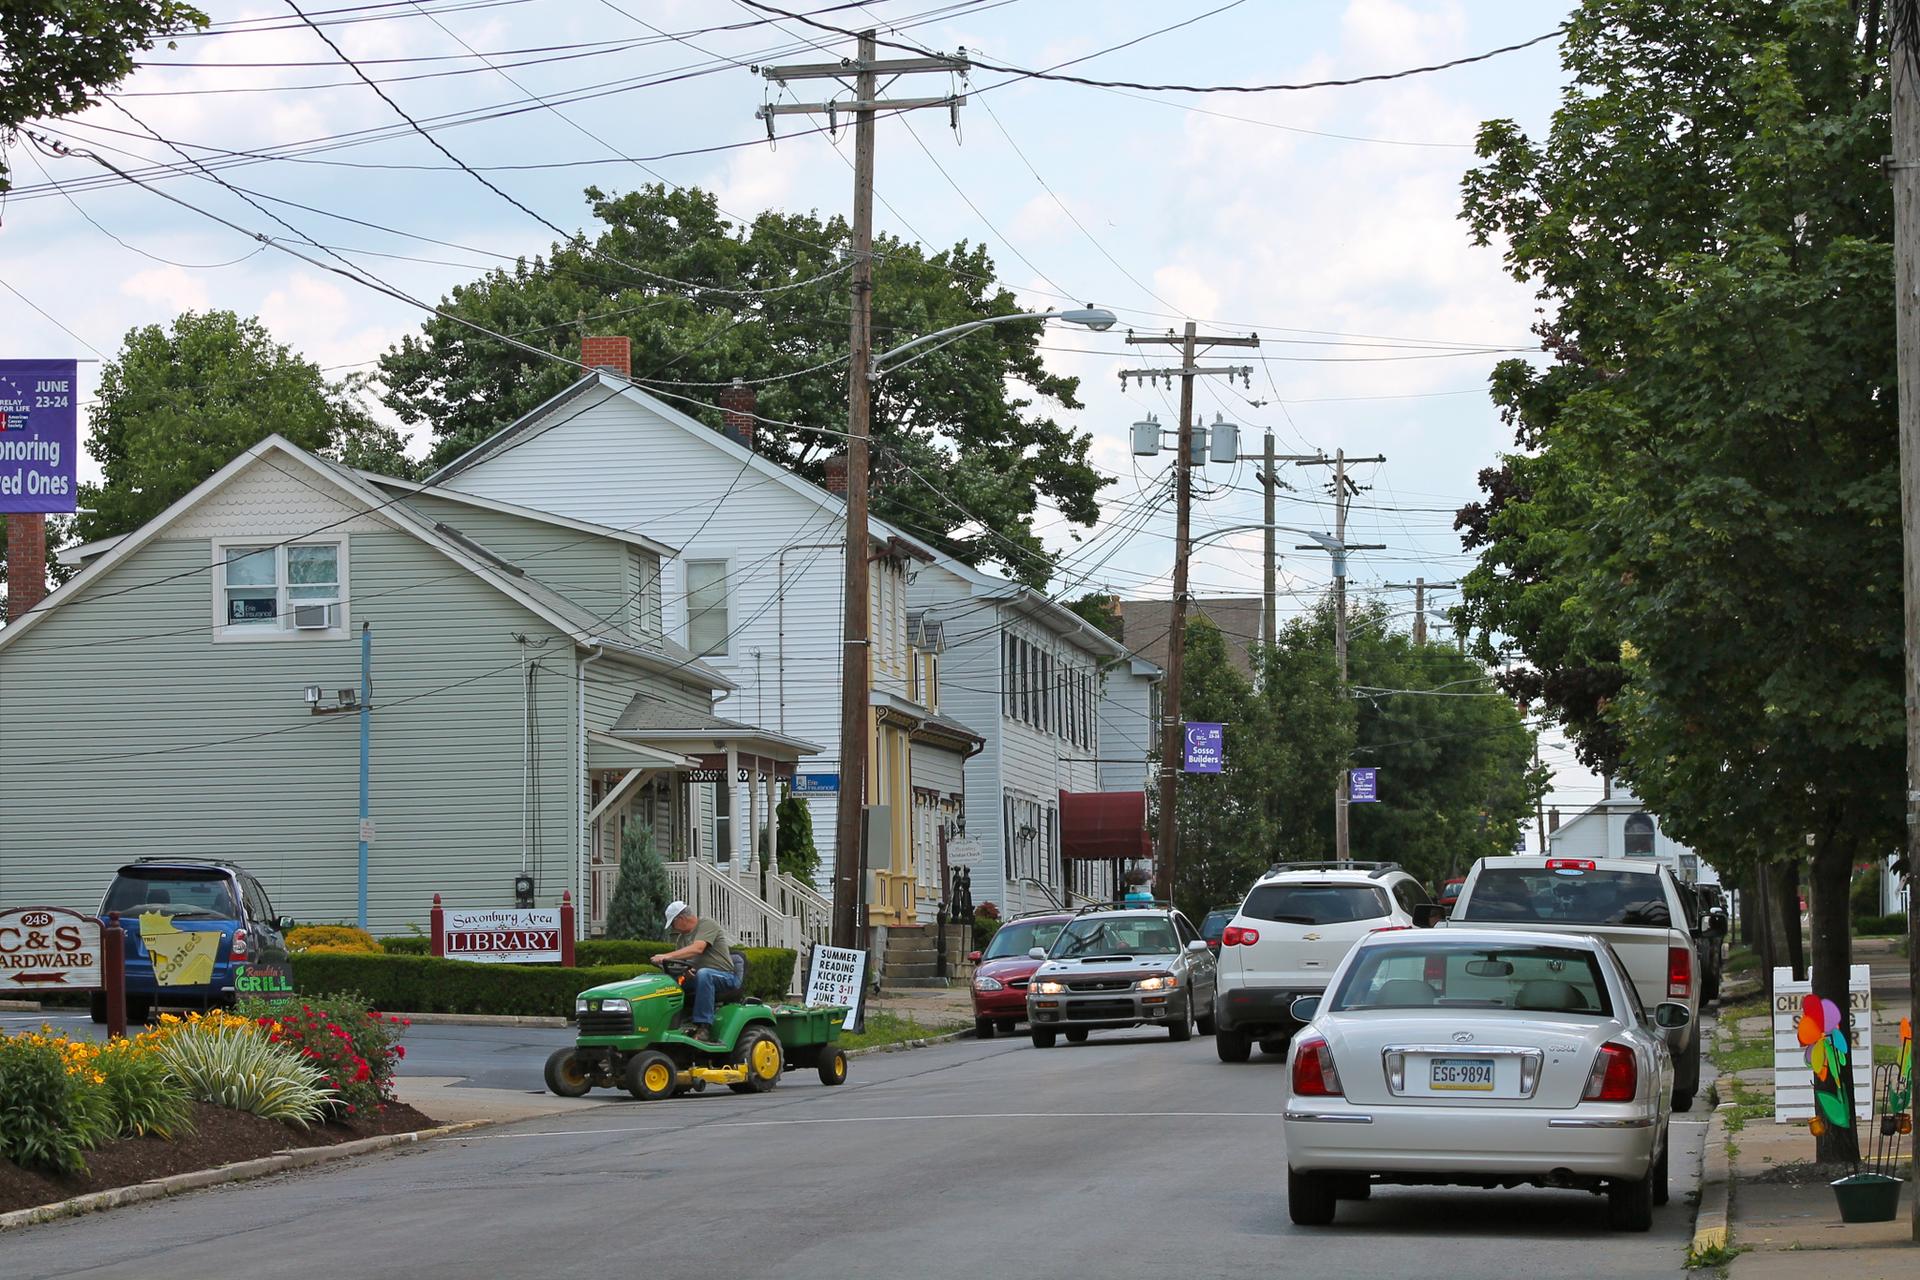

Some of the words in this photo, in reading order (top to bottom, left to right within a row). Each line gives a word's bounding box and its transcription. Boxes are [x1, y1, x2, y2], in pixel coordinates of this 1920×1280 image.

[35, 380, 69, 393] JUNE
[35, 396, 69, 408] 23-24
[27, 469, 69, 496] Ones
[1192, 746, 1215, 755] Sosso
[1188, 755, 1219, 763] Builders
[25, 914, 49, 926] 248
[453, 911, 518, 929] Saxonburg
[521, 911, 552, 924] Area
[450, 931, 556, 952] LIBRARY
[821, 949, 857, 963] SUMMER
[819, 960, 855, 973] READING
[237, 975, 293, 991] GRILL
[817, 971, 853, 984] KICKOFF
[813, 982, 835, 992] AGES
[813, 992, 834, 1003] JUNE
[839, 995, 848, 1004] 12
